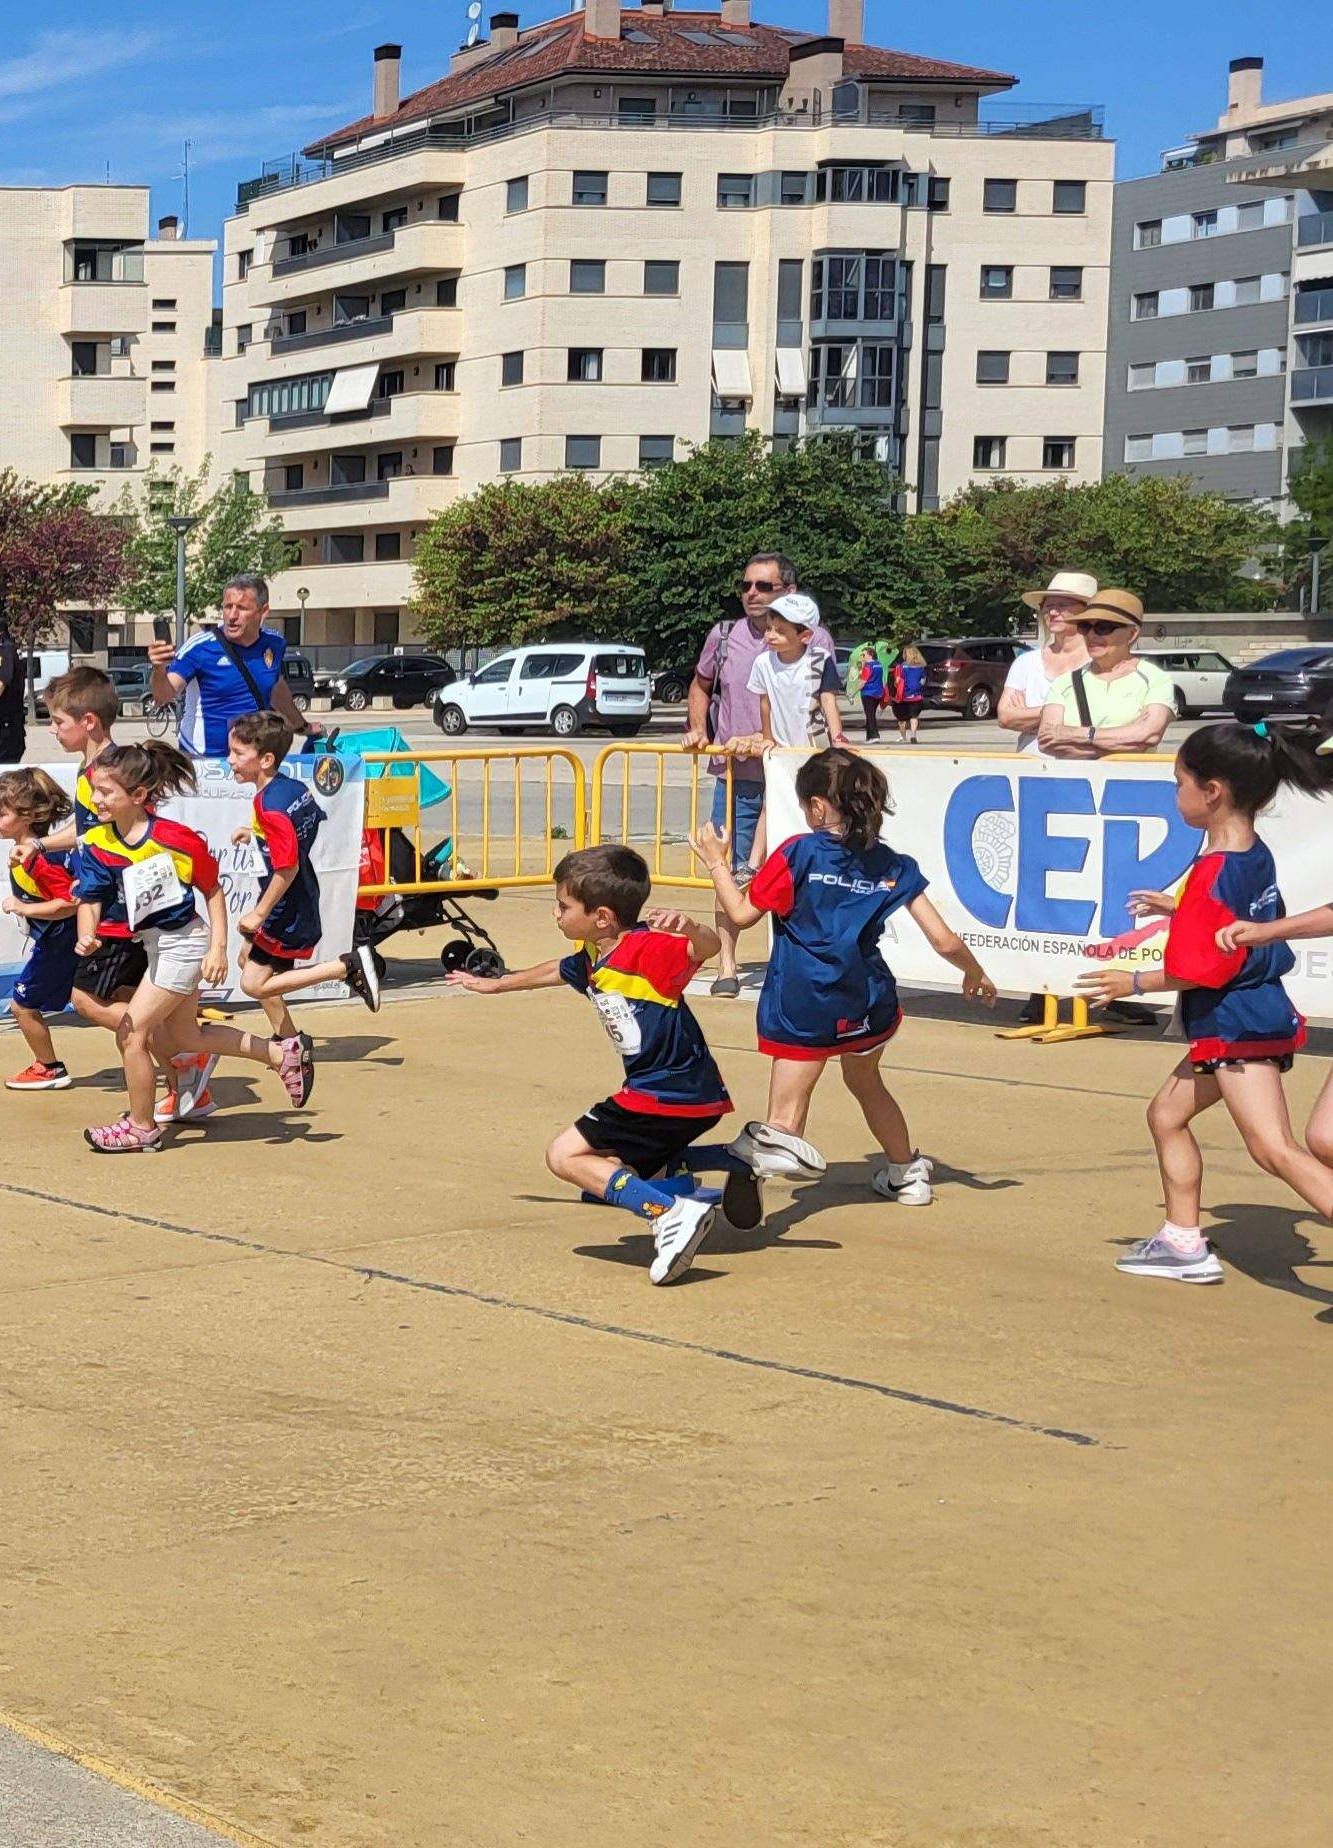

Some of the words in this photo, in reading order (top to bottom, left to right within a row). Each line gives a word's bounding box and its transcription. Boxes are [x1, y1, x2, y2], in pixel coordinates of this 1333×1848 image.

[943, 774, 1206, 938] CEP
[957, 932, 1040, 954] FEDERACIÓN
[1043, 939, 1114, 959] ESPAÑOLA
[1118, 947, 1138, 961] DE
